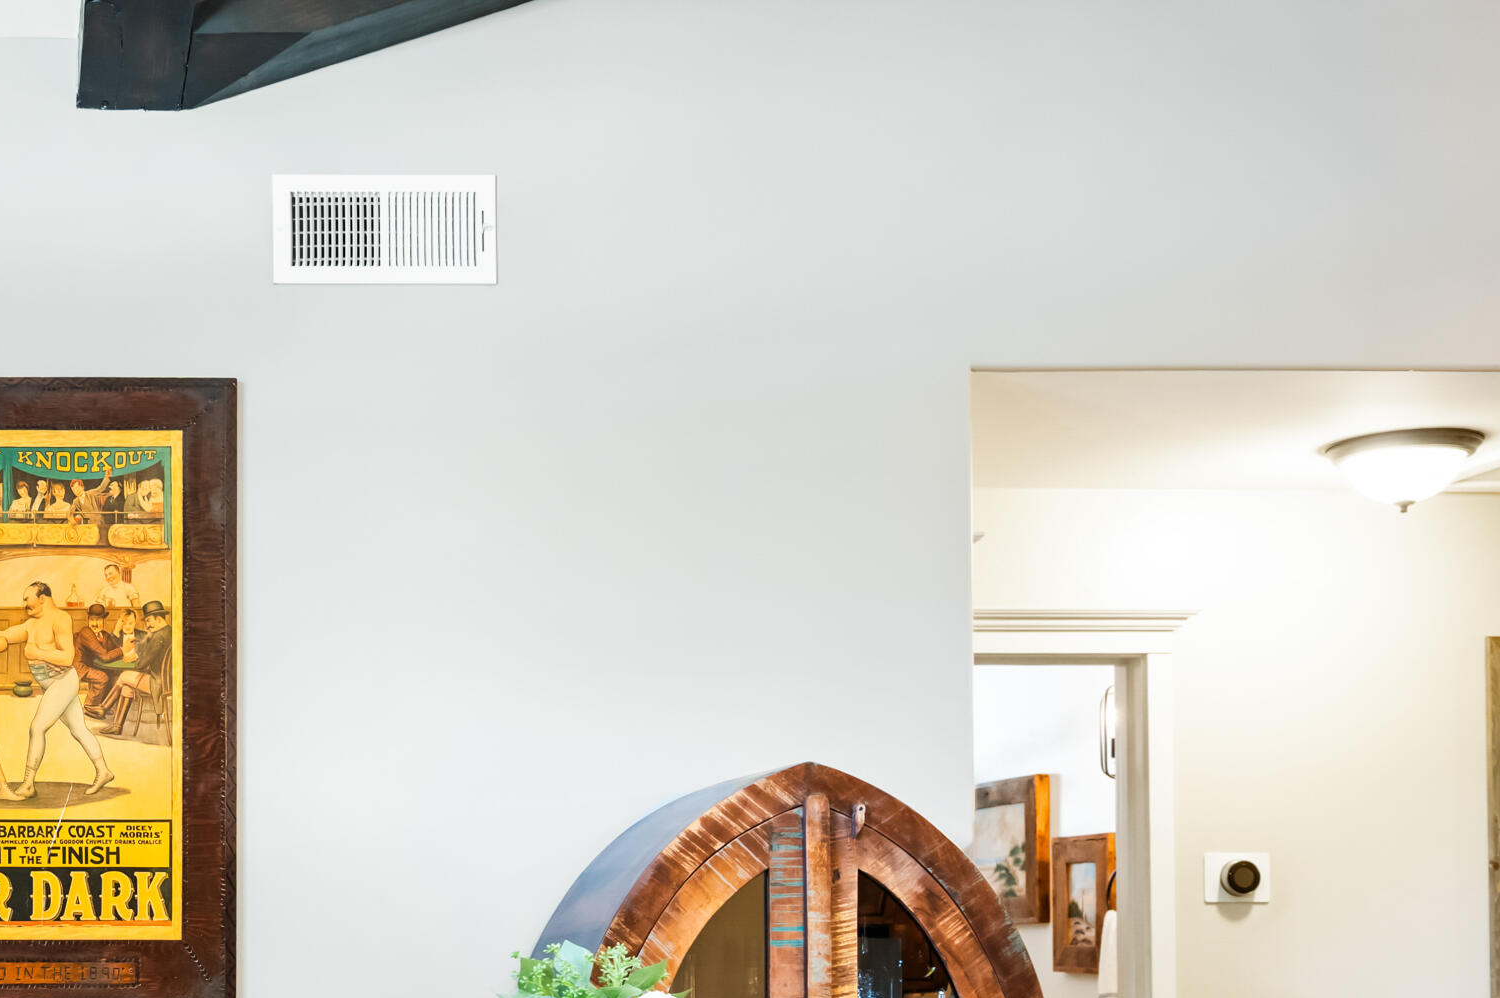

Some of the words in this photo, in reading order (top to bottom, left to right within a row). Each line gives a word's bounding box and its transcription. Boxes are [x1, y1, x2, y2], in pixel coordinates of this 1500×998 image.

[17, 450, 157, 473] KNOCKOUT
[68, 825, 115, 838] COAST
[23, 846, 37, 854] TO
[47, 846, 120, 865] FINISH
[19, 855, 42, 864] THE
[30, 870, 170, 922] DARK
[15, 966, 35, 981] IN
[41, 966, 71, 981] THE
